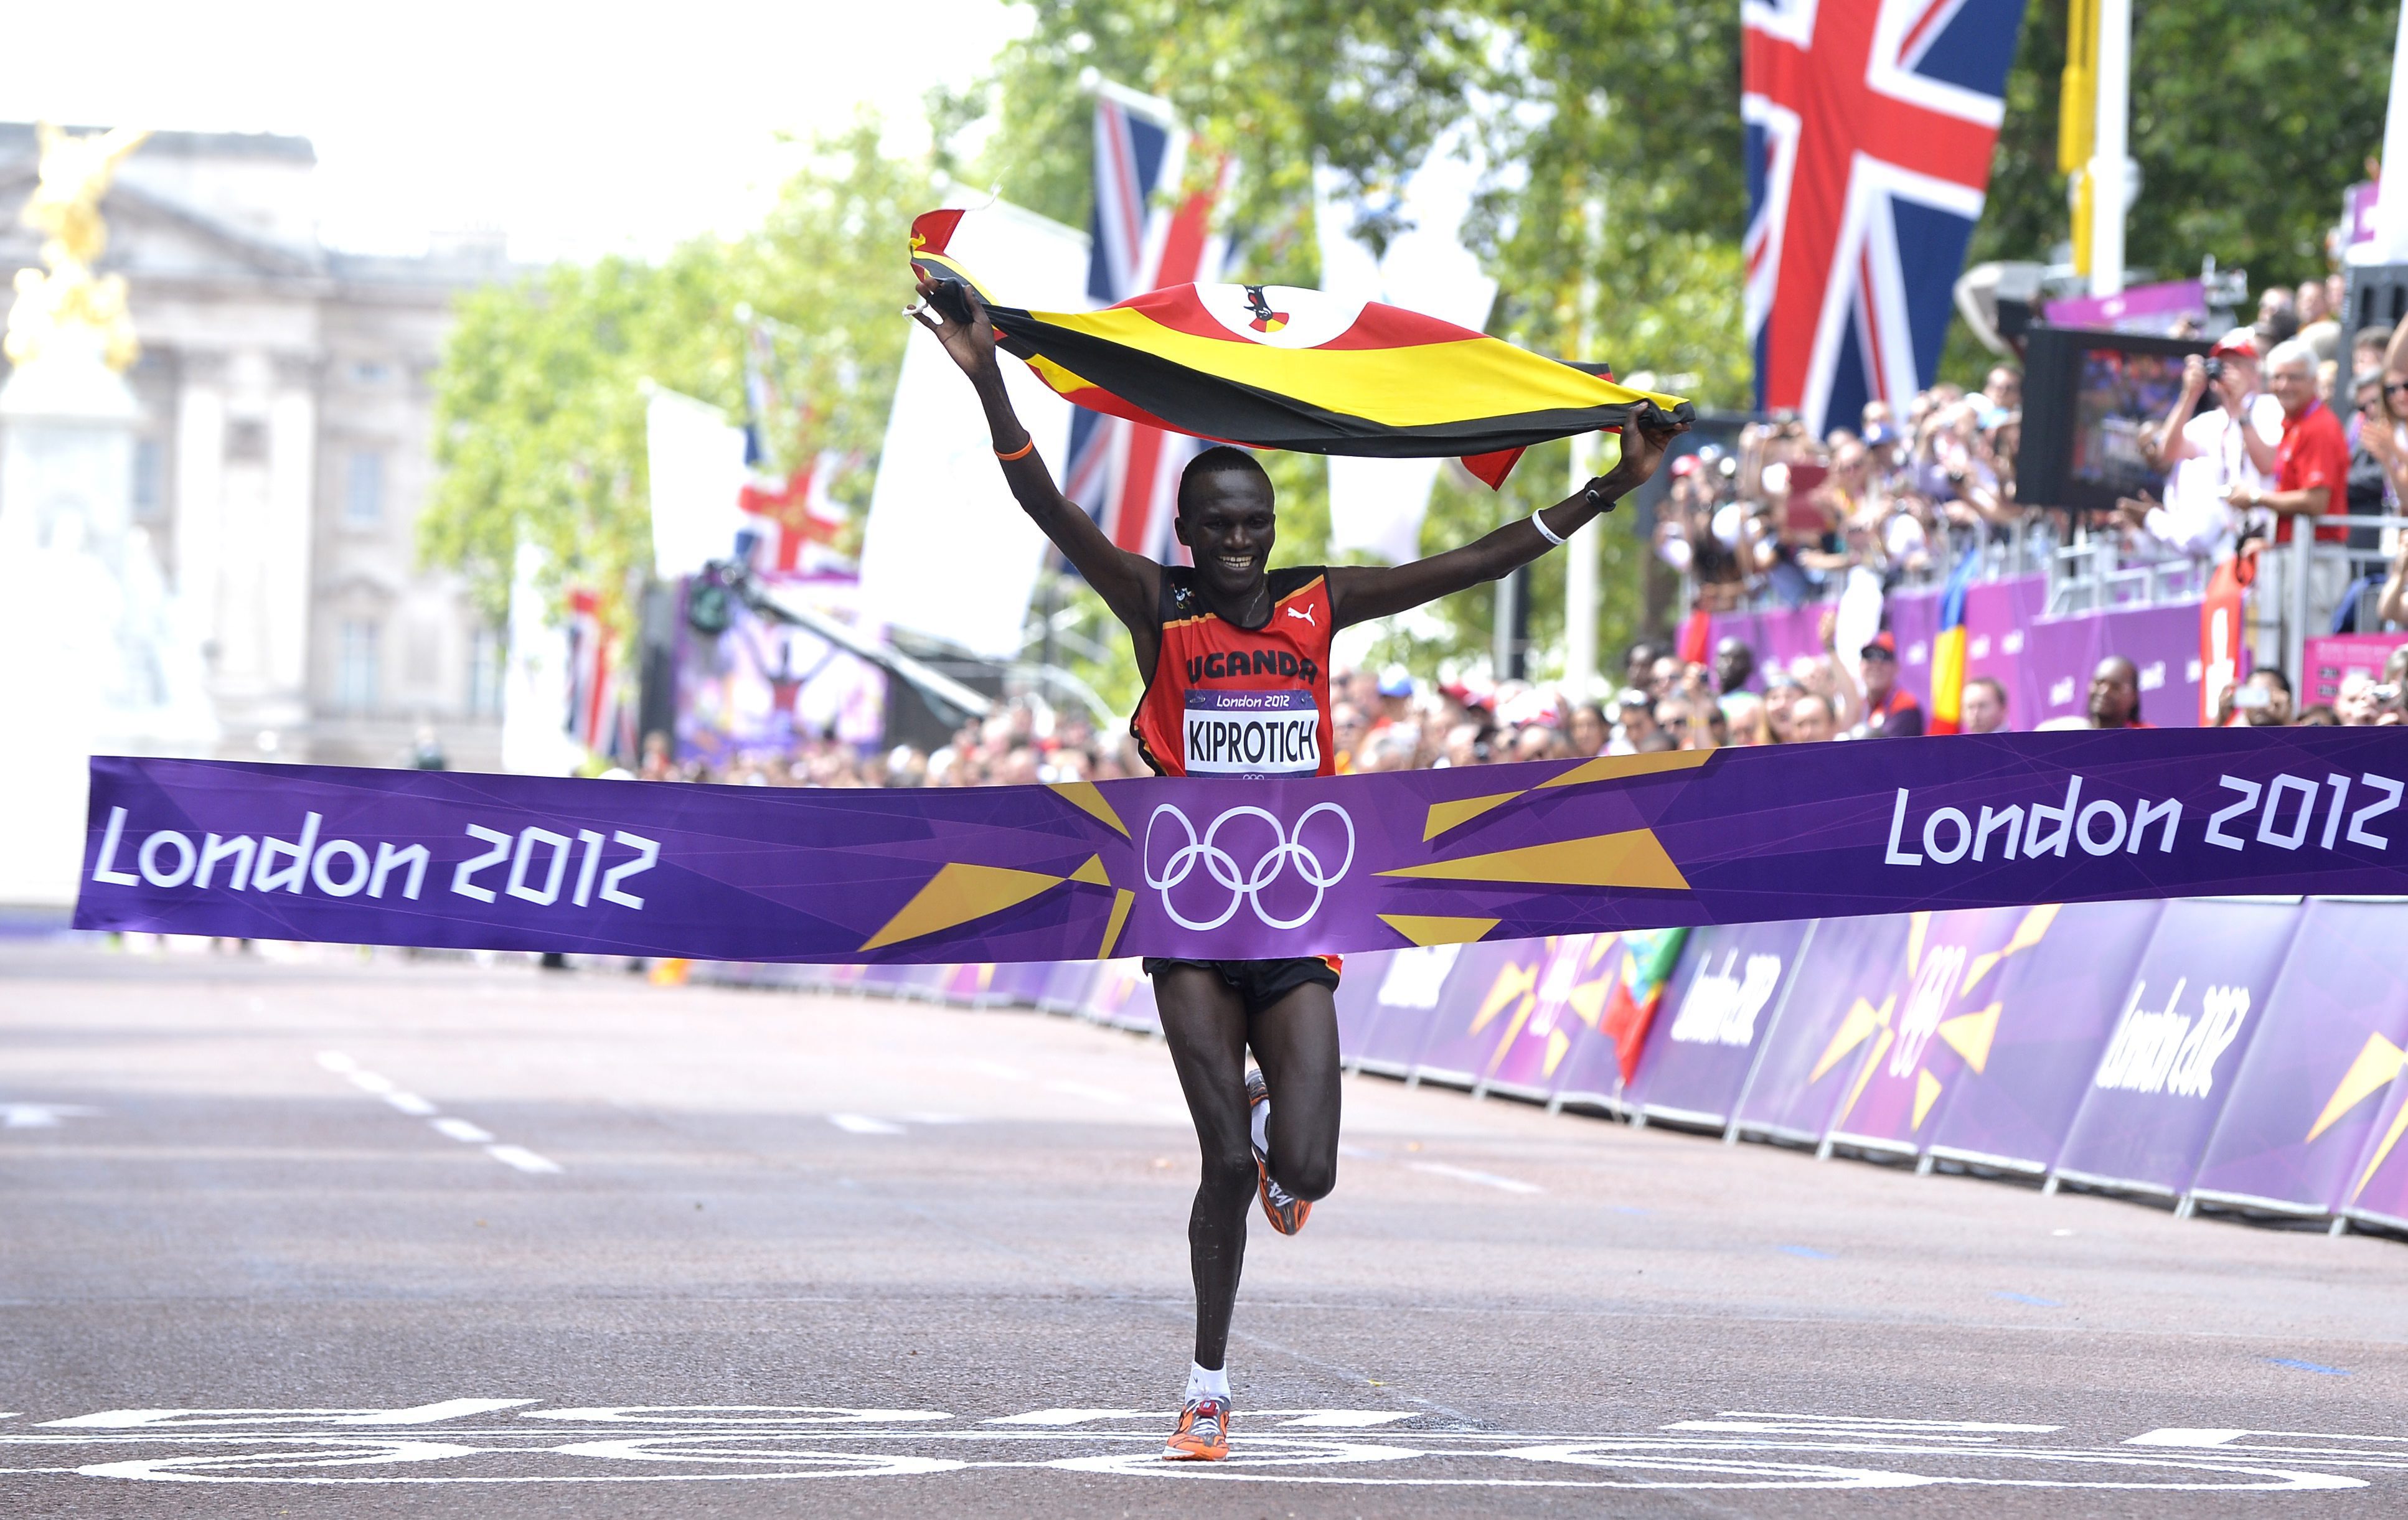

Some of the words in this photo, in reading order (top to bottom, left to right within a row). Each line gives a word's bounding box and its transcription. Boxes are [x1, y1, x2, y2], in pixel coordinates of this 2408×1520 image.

[1187, 650, 1319, 685] UGANDA
[1216, 695, 1262, 708] London
[1264, 695, 1290, 708] 2012
[1189, 720, 1315, 764] KIPROTICH
[1884, 774, 2183, 866] London
[2204, 772, 2405, 851] 2012
[92, 805, 431, 901] London
[450, 823, 661, 911] 2012
